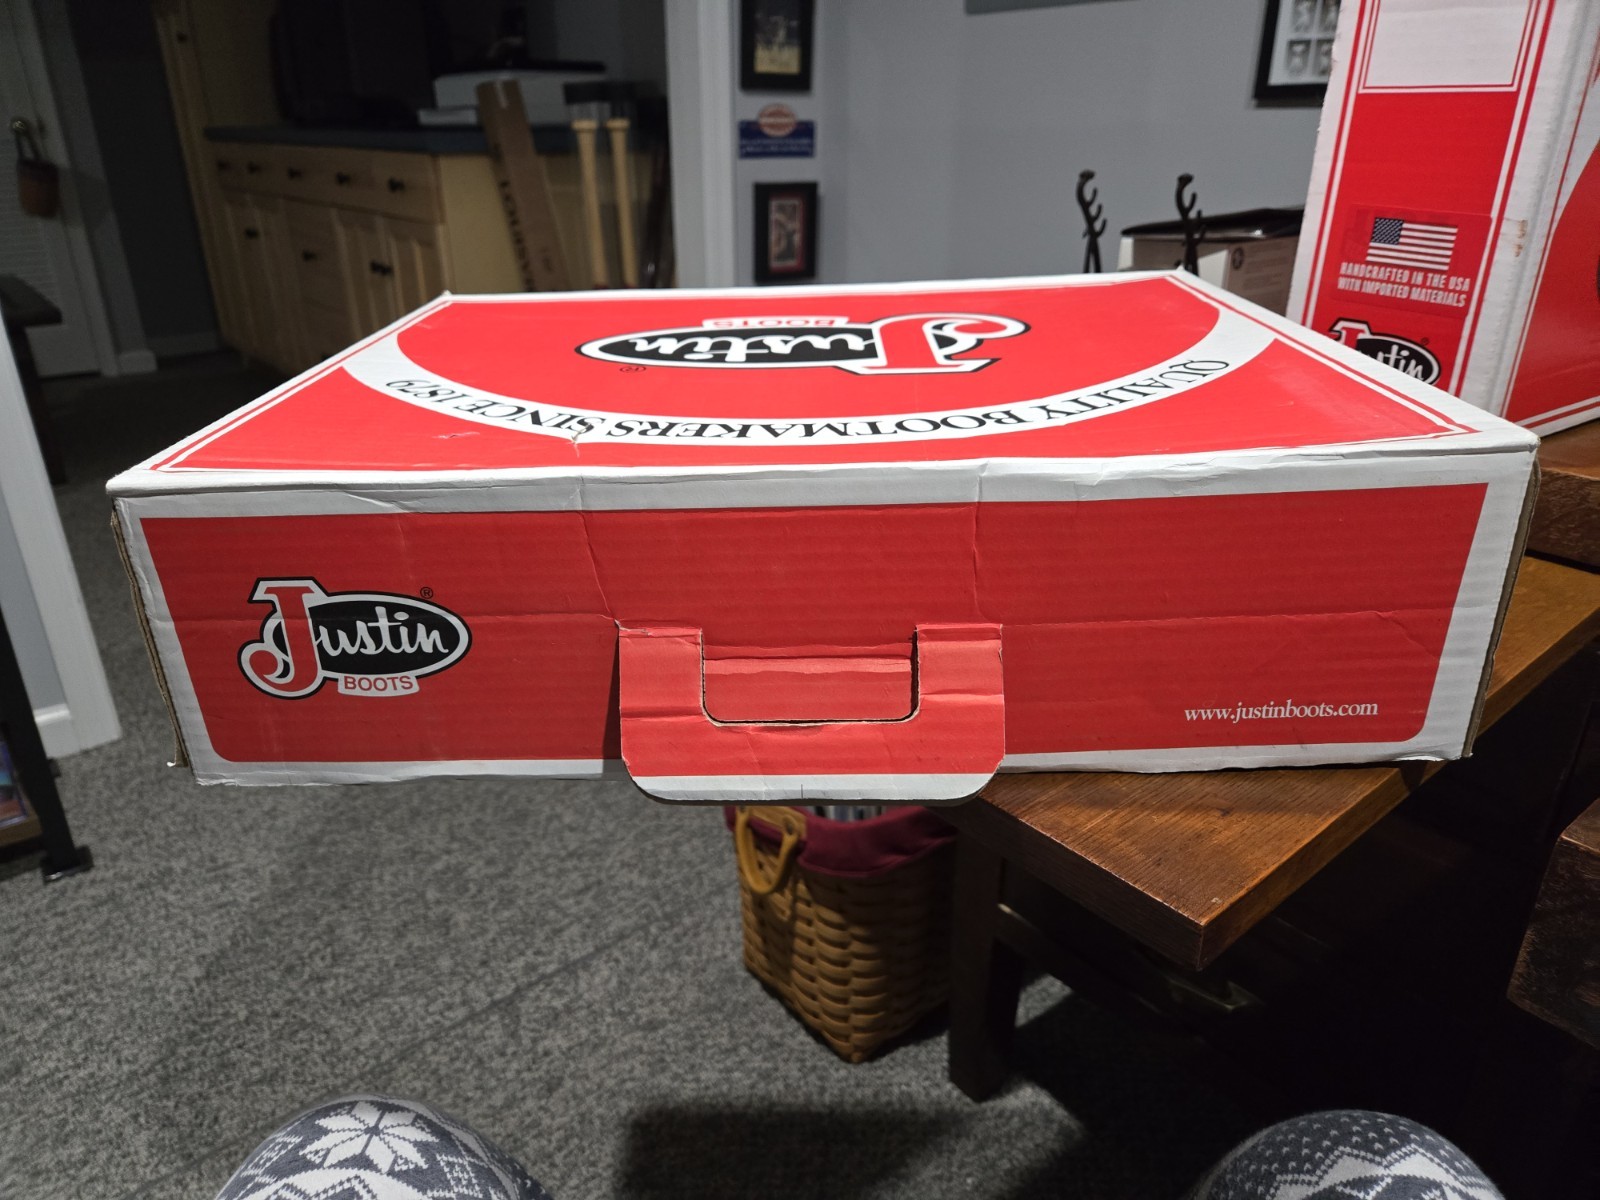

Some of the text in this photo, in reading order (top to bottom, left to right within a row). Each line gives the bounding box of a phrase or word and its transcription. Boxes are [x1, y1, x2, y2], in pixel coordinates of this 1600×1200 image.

[1337, 276, 1467, 307] WITH IMPORTED MATERIALS
[1340, 262, 1471, 292] HANDCRAFTED IN THE USA
[713, 319, 836, 327] BOOTS
[628, 313, 1031, 374] Justin
[386, 359, 1229, 438] QUALITY BOOTMAKERS SINCE 1879
[243, 580, 450, 693] Justin
[343, 675, 414, 692] BOOTS
[1184, 699, 1379, 723] www.justinboots.com
